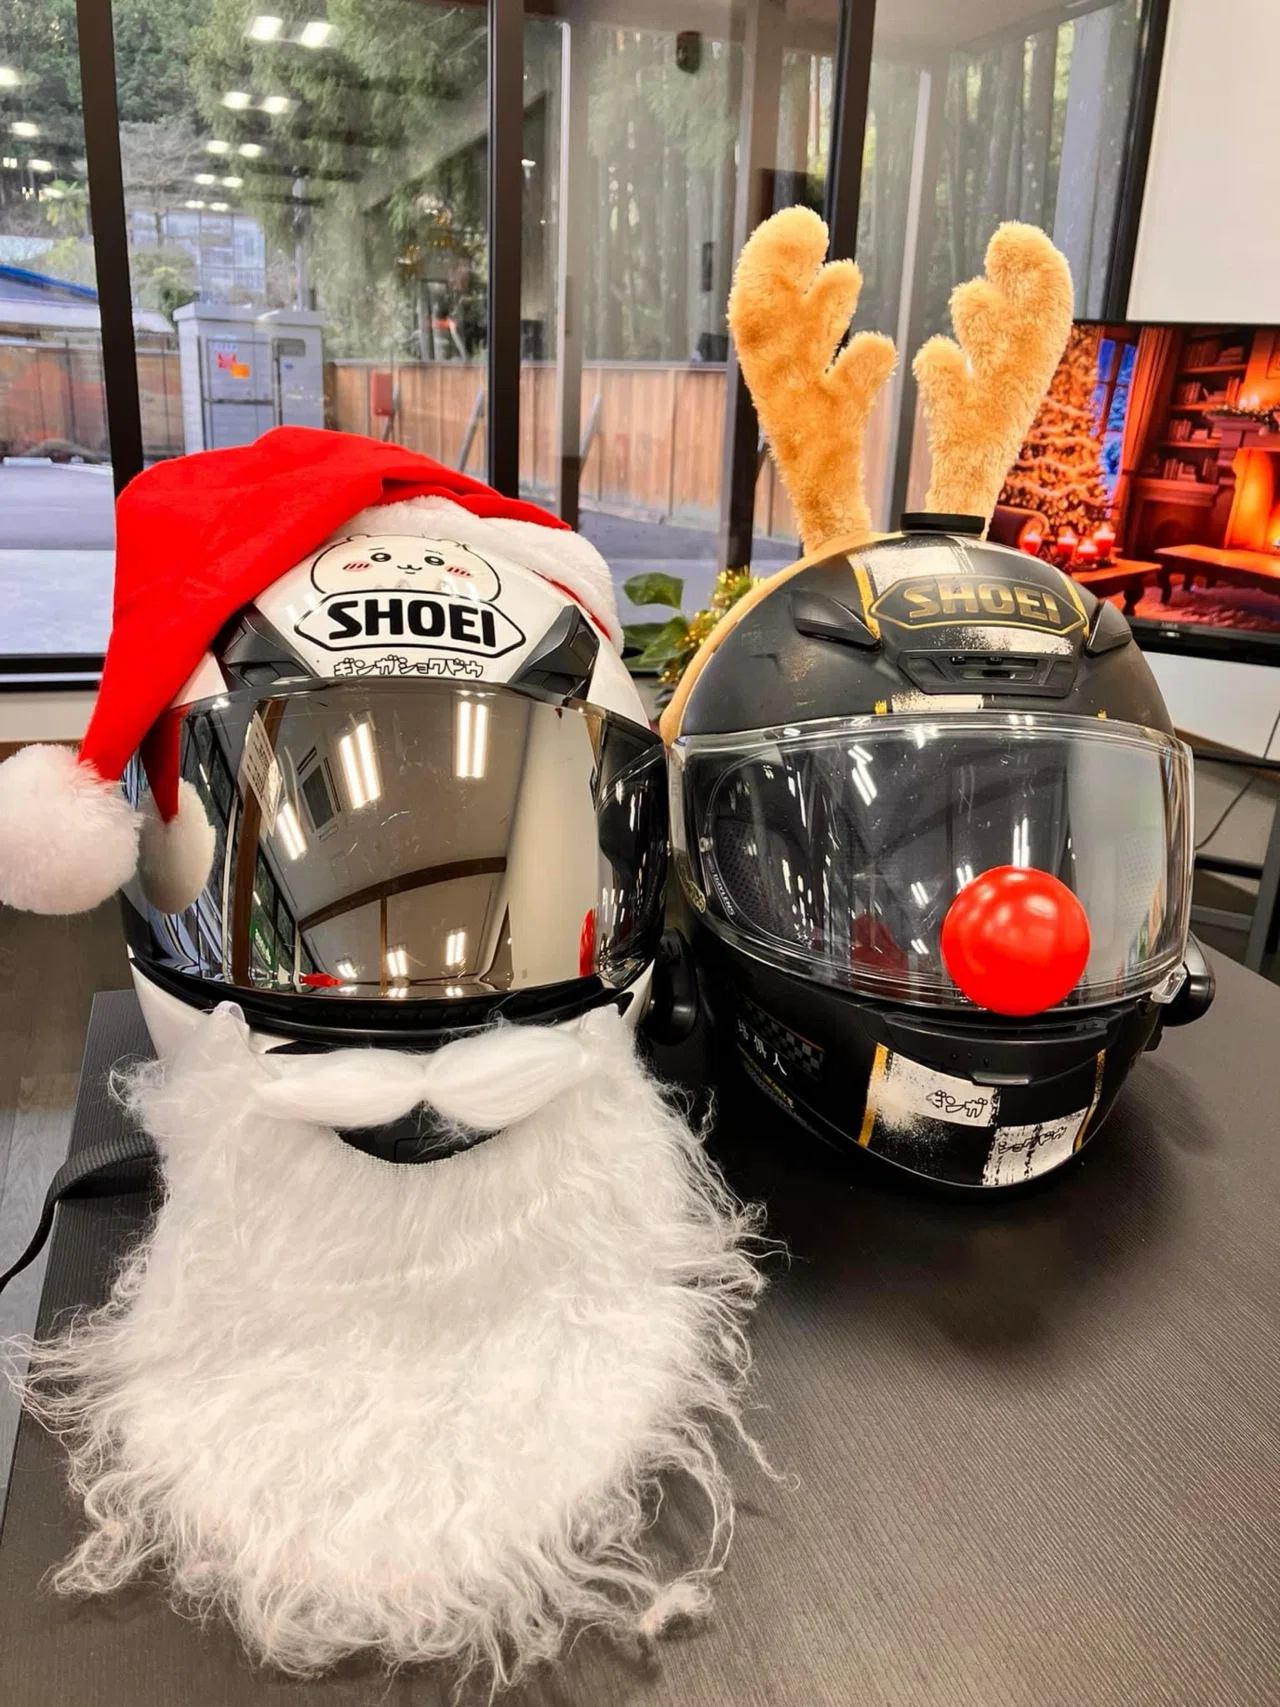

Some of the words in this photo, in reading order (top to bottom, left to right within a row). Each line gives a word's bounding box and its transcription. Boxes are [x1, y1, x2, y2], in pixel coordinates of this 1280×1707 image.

[327, 598, 496, 648] SHOEI
[903, 581, 1061, 625] SHOEI
[926, 1089, 989, 1119] ギンガ
